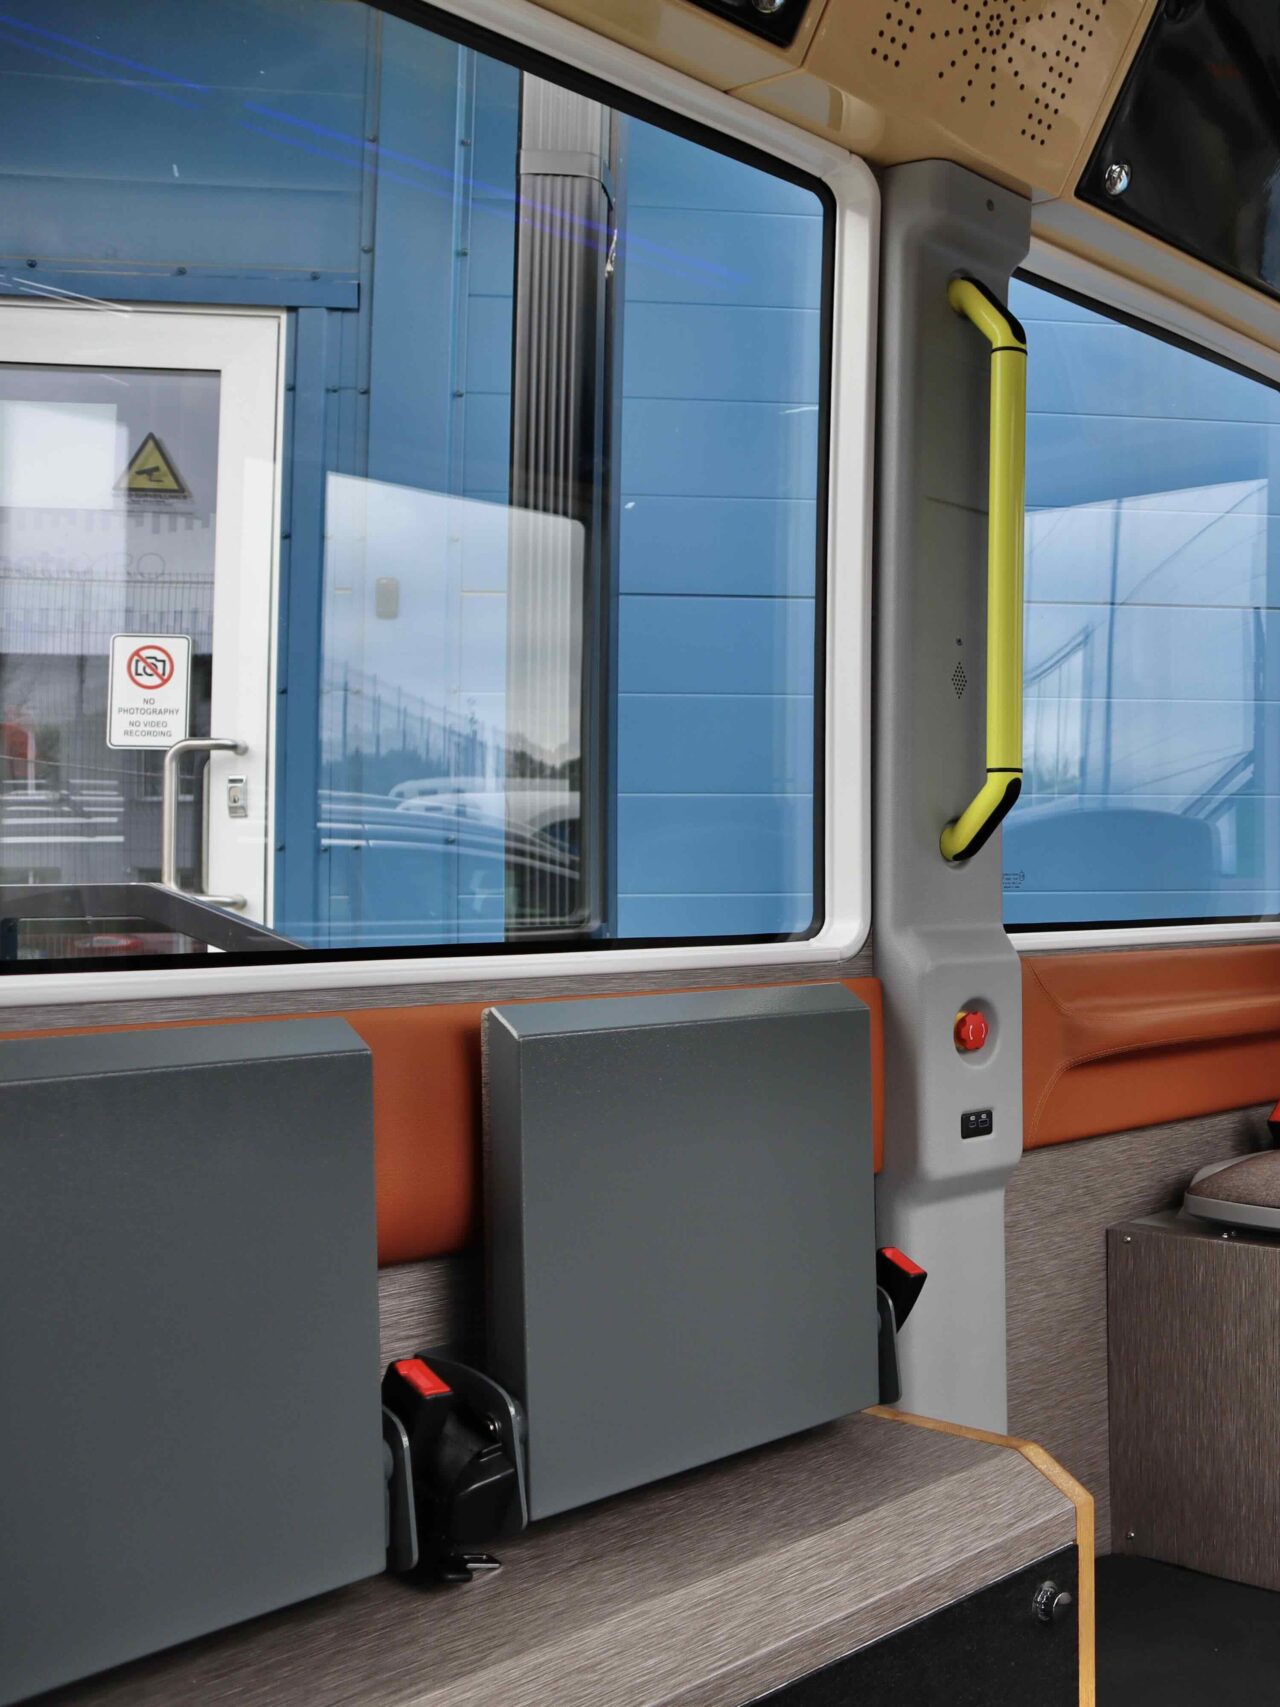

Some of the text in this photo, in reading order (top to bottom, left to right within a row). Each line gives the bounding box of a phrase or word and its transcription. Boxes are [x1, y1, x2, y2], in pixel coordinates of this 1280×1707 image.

[117, 707, 180, 716] PHOTOGRAPHY
[129, 720, 168, 728] NO VIDEO
[123, 729, 172, 738] RECORDING
